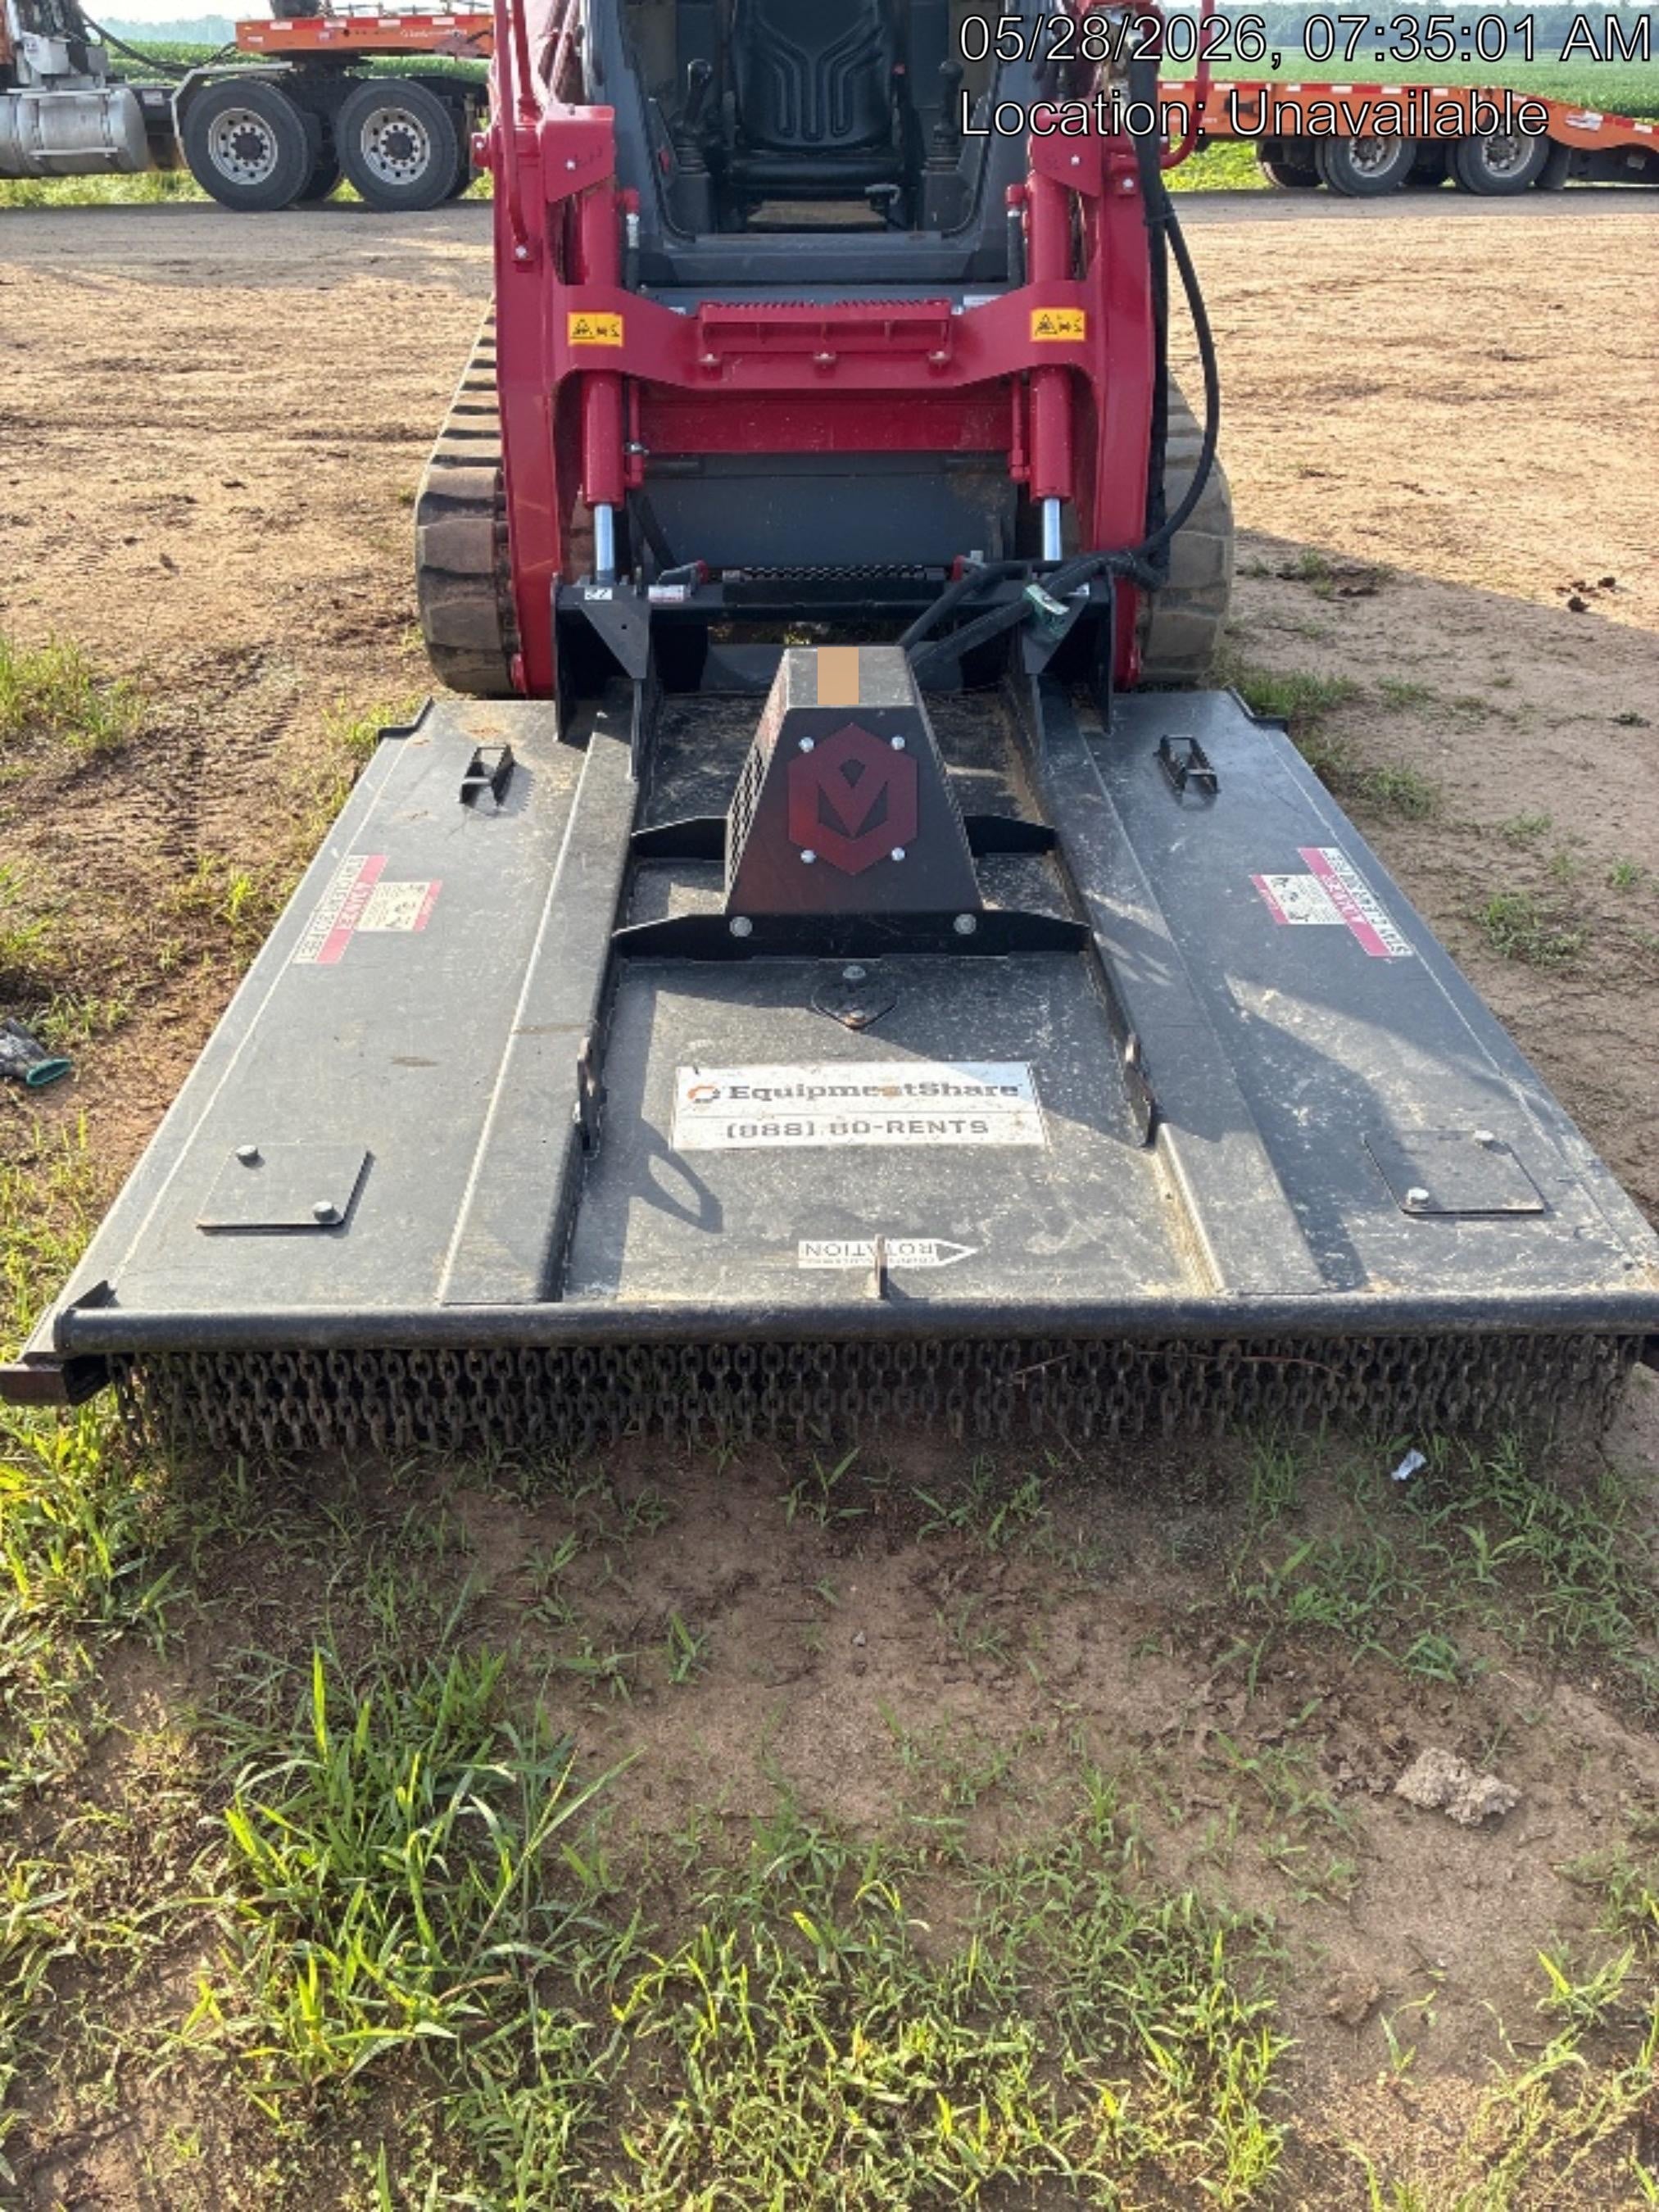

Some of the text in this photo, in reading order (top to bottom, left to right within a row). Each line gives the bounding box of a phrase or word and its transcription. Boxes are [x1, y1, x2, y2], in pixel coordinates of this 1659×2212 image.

[729, 1083, 1019, 1101] EquipmentShare
[728, 1120, 989, 1138] (888) 80-RENTS
